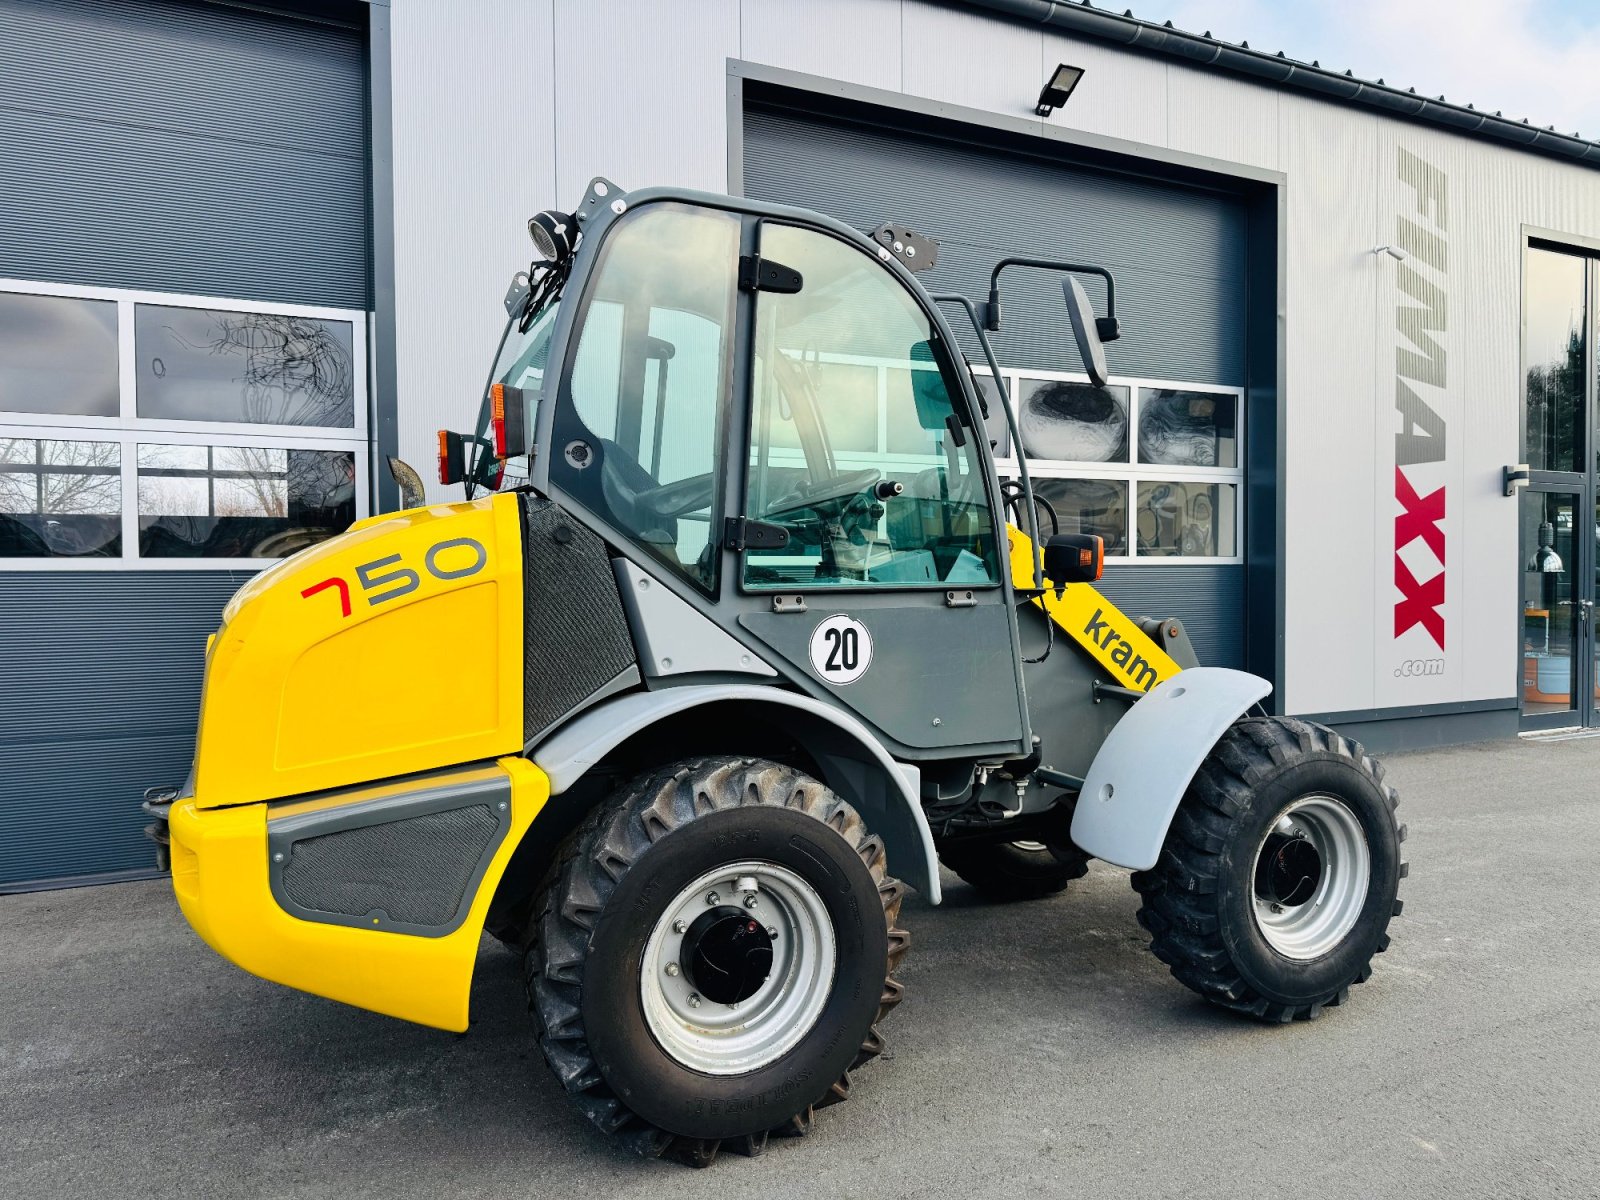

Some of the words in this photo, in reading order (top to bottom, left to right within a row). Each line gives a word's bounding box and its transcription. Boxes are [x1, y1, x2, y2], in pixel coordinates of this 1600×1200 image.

[1394, 146, 1448, 652] FIMAXX
[300, 537, 487, 618] 750
[824, 627, 859, 672] 20
[1083, 607, 1164, 693] kram
[1393, 658, 1445, 678] .com
